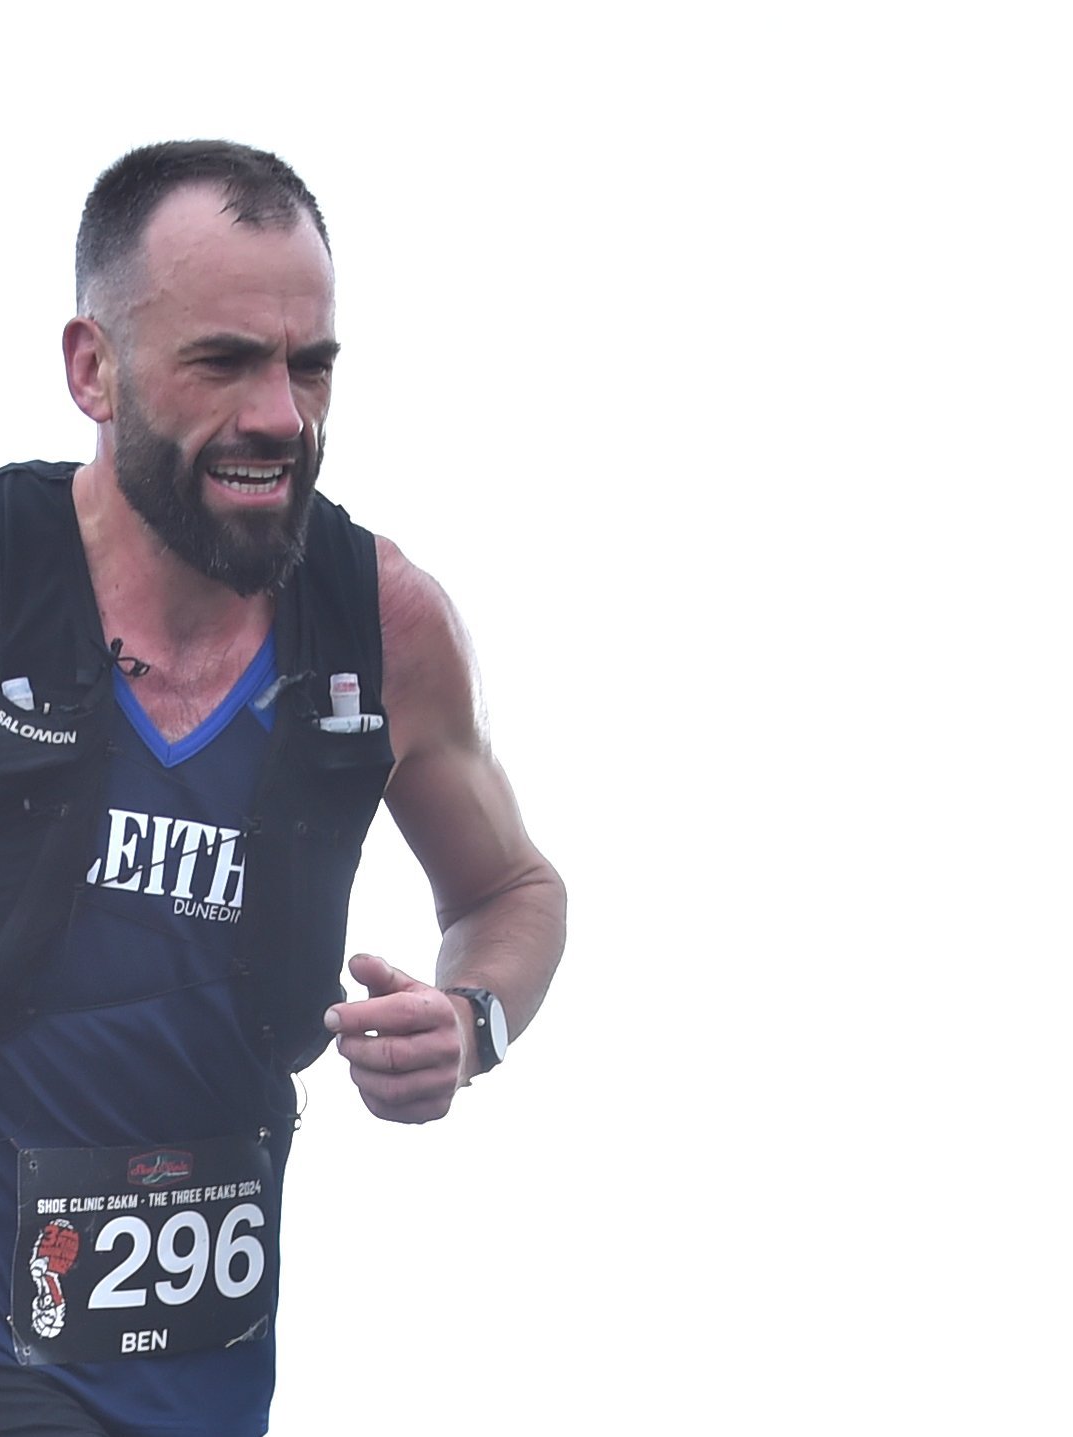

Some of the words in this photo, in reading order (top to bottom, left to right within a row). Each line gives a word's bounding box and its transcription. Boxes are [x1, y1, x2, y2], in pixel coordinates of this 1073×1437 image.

[37, 1198, 67, 1214] SHOE
[69, 1196, 105, 1212] CLINIC
[107, 1194, 138, 1210] 26KM
[148, 1191, 168, 1207] THE
[171, 1187, 203, 1205] THREE
[204, 1183, 237, 1201] PEAKS
[238, 1178, 261, 1197] 2024
[88, 1203, 265, 1309] 296
[121, 1328, 168, 1353] BEN
